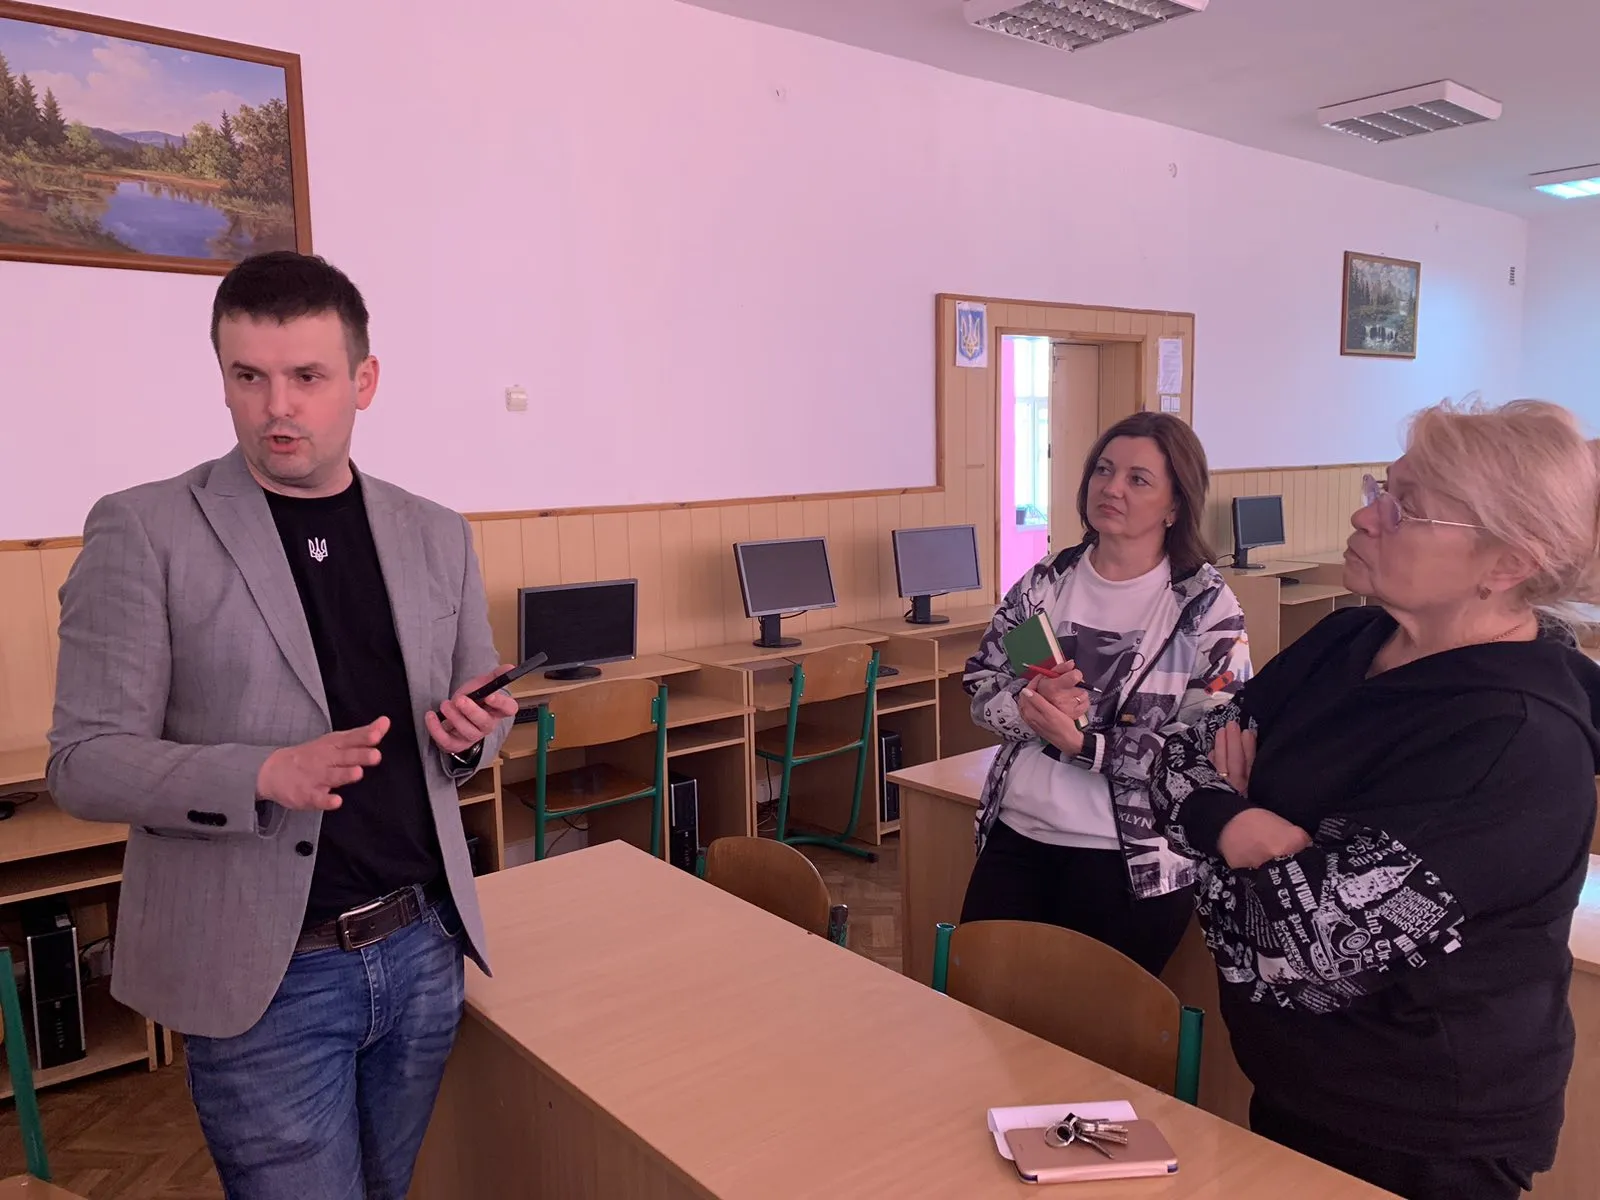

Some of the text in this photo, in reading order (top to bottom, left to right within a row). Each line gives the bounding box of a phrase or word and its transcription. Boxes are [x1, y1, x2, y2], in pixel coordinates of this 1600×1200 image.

[1119, 811, 1152, 829] KLYN
[1286, 860, 1318, 912] NEW YORK
[1288, 913, 1310, 943] Paper
